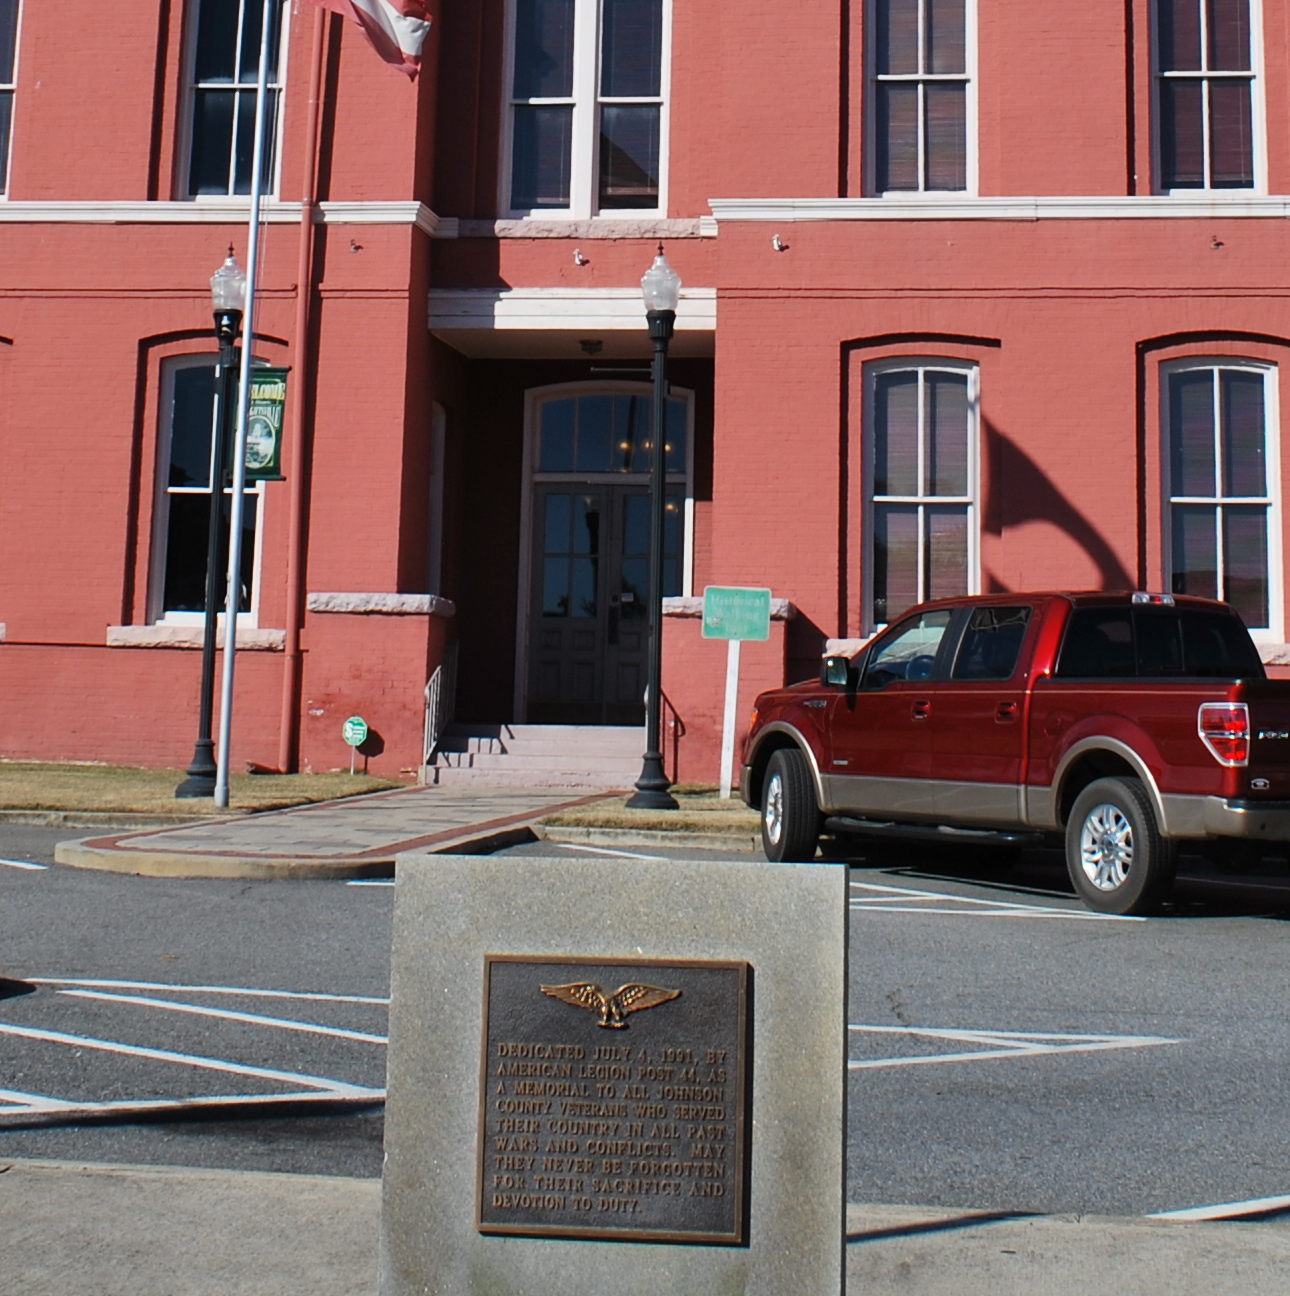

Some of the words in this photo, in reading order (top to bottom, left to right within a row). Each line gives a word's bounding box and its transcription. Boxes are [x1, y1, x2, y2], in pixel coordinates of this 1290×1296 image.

[250, 383, 286, 400] ELCOME
[711, 594, 764, 607] Historical
[497, 1042, 585, 1060] DEDICATED
[593, 1045, 631, 1062] JULY
[638, 1048, 652, 1064] 4,
[661, 1048, 699, 1066] 1991,
[706, 1049, 726, 1065] BY
[496, 1062, 572, 1079] AMERICAN
[579, 1065, 631, 1081] LEGION
[638, 1066, 675, 1082] POST
[679, 1068, 701, 1085] 44,
[707, 1069, 727, 1084] AS
[496, 1080, 506, 1095] A
[513, 1082, 590, 1097] MEMORIAL
[596, 1084, 615, 1098] TO
[622, 1084, 649, 1099] ALL
[657, 1085, 724, 1102] JOHNSON
[496, 1100, 552, 1115] COUNTY
[560, 1101, 628, 1117] VETERANS
[635, 1103, 667, 1120] WHO
[672, 1105, 726, 1121] SERVED
[495, 1118, 540, 1132] THEIR
[548, 1119, 620, 1136] COUNTRY
[627, 1122, 644, 1137] IN
[650, 1123, 680, 1138] ALL
[687, 1124, 727, 1140] PAST
[494, 1137, 538, 1152] WARS
[545, 1138, 579, 1154] AND
[586, 1140, 676, 1157] CONFLICTS.
[690, 1143, 726, 1159] MAY
[493, 1155, 535, 1171] THEY
[542, 1157, 594, 1173] NEVER
[602, 1159, 623, 1175] BE
[629, 1160, 725, 1178] FORGOTTEN
[492, 1174, 526, 1189] FOR
[534, 1176, 584, 1192] THEIR
[591, 1178, 681, 1196] SACRIFICE
[688, 1182, 725, 1197] AND
[492, 1192, 566, 1209] DEVOTION
[573, 1196, 592, 1212] TO
[599, 1197, 643, 1214] DUTY.
